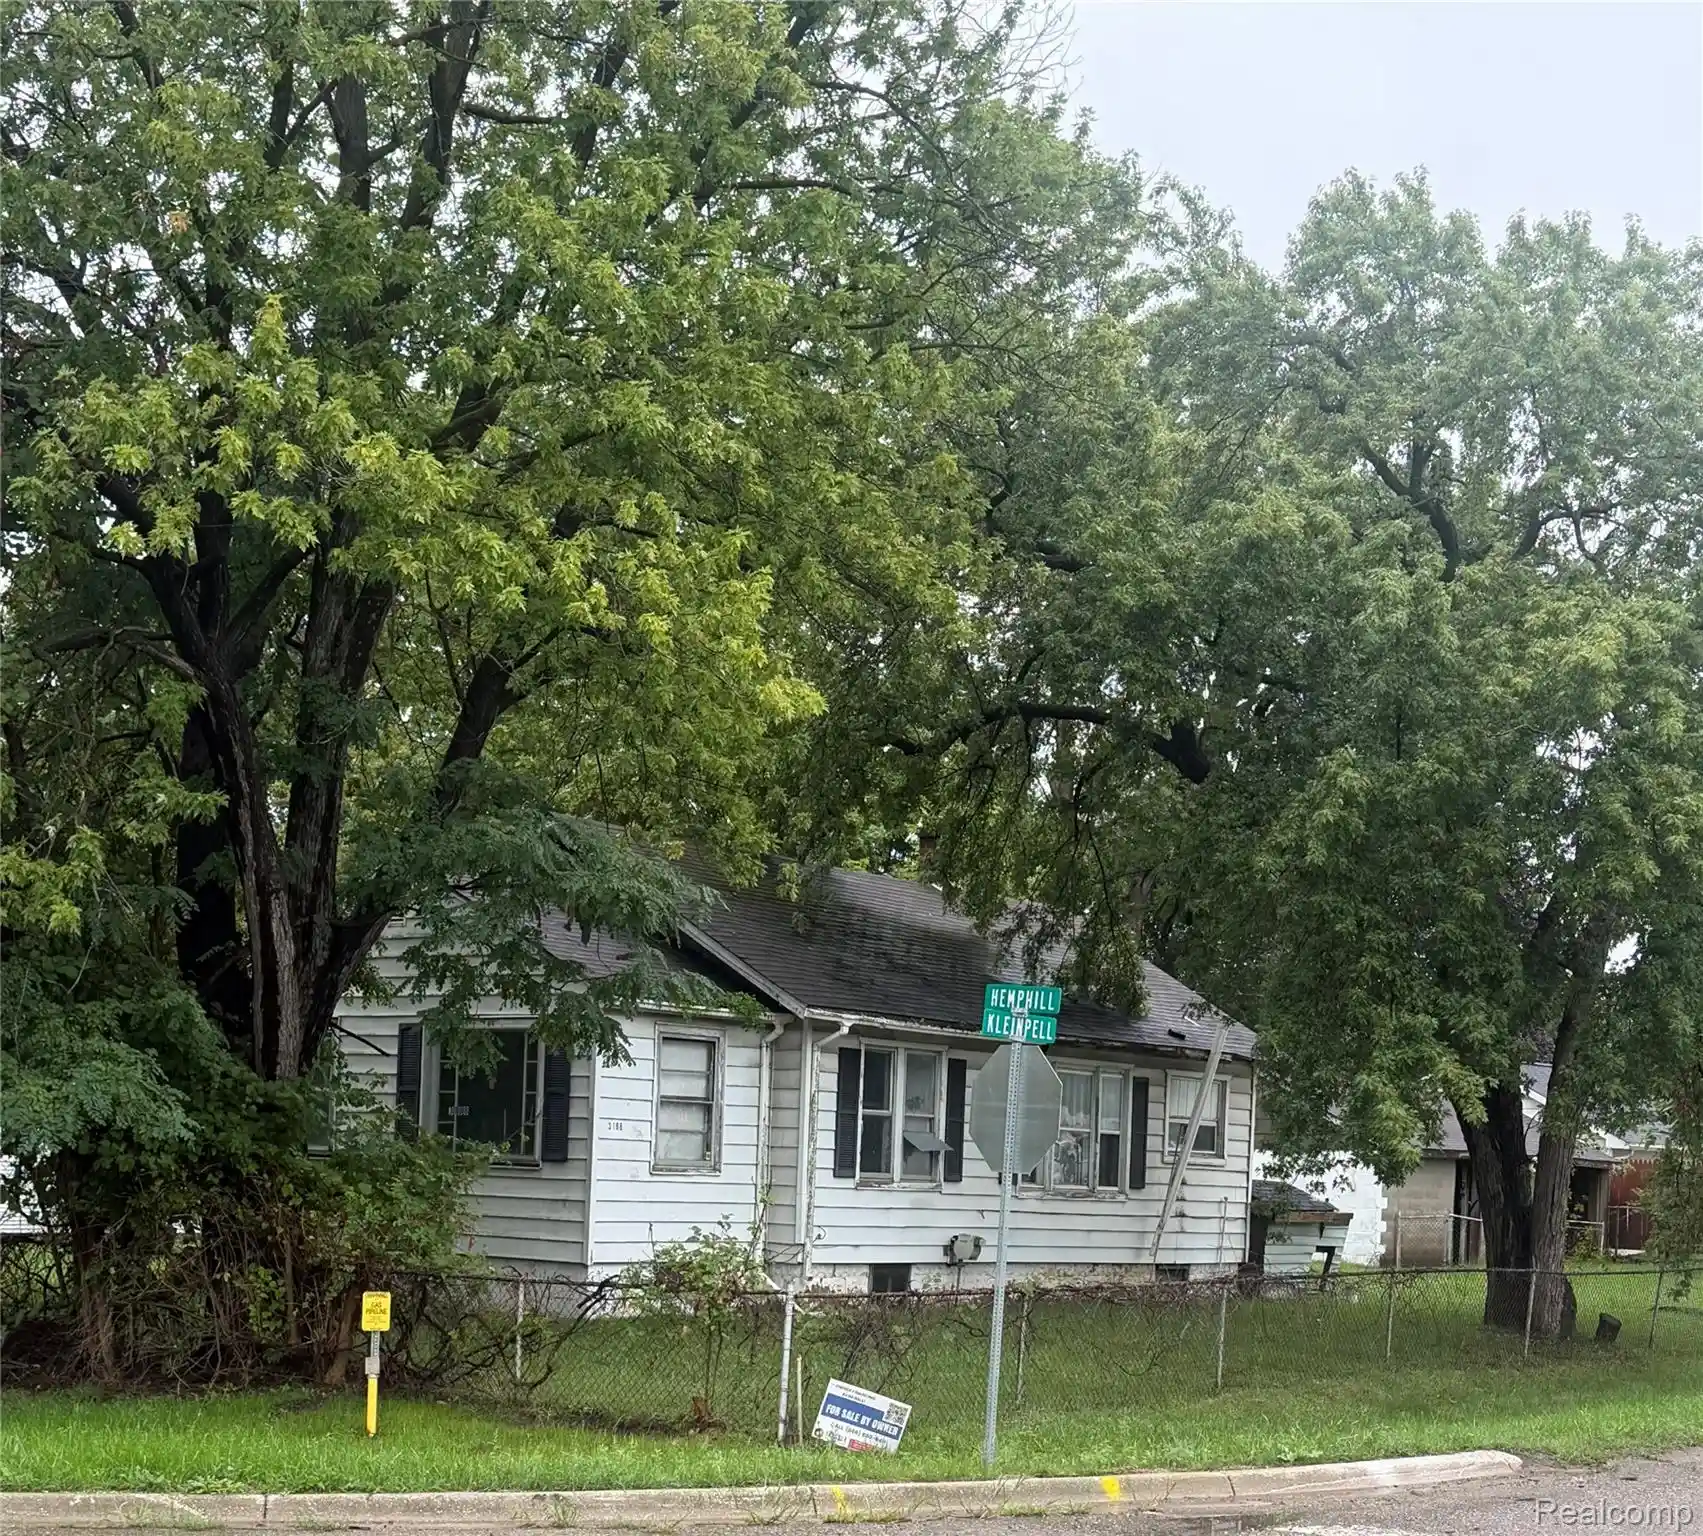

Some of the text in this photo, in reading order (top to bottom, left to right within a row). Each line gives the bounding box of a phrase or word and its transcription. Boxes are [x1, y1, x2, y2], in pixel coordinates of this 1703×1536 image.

[990, 988, 1055, 1011] HEMPHILL
[986, 1013, 1053, 1041] KLEINPELL
[825, 1404, 841, 1417] FOR
[841, 1408, 860, 1423] SALE
[860, 1415, 872, 1426] BY
[871, 1419, 899, 1436] OWNER
